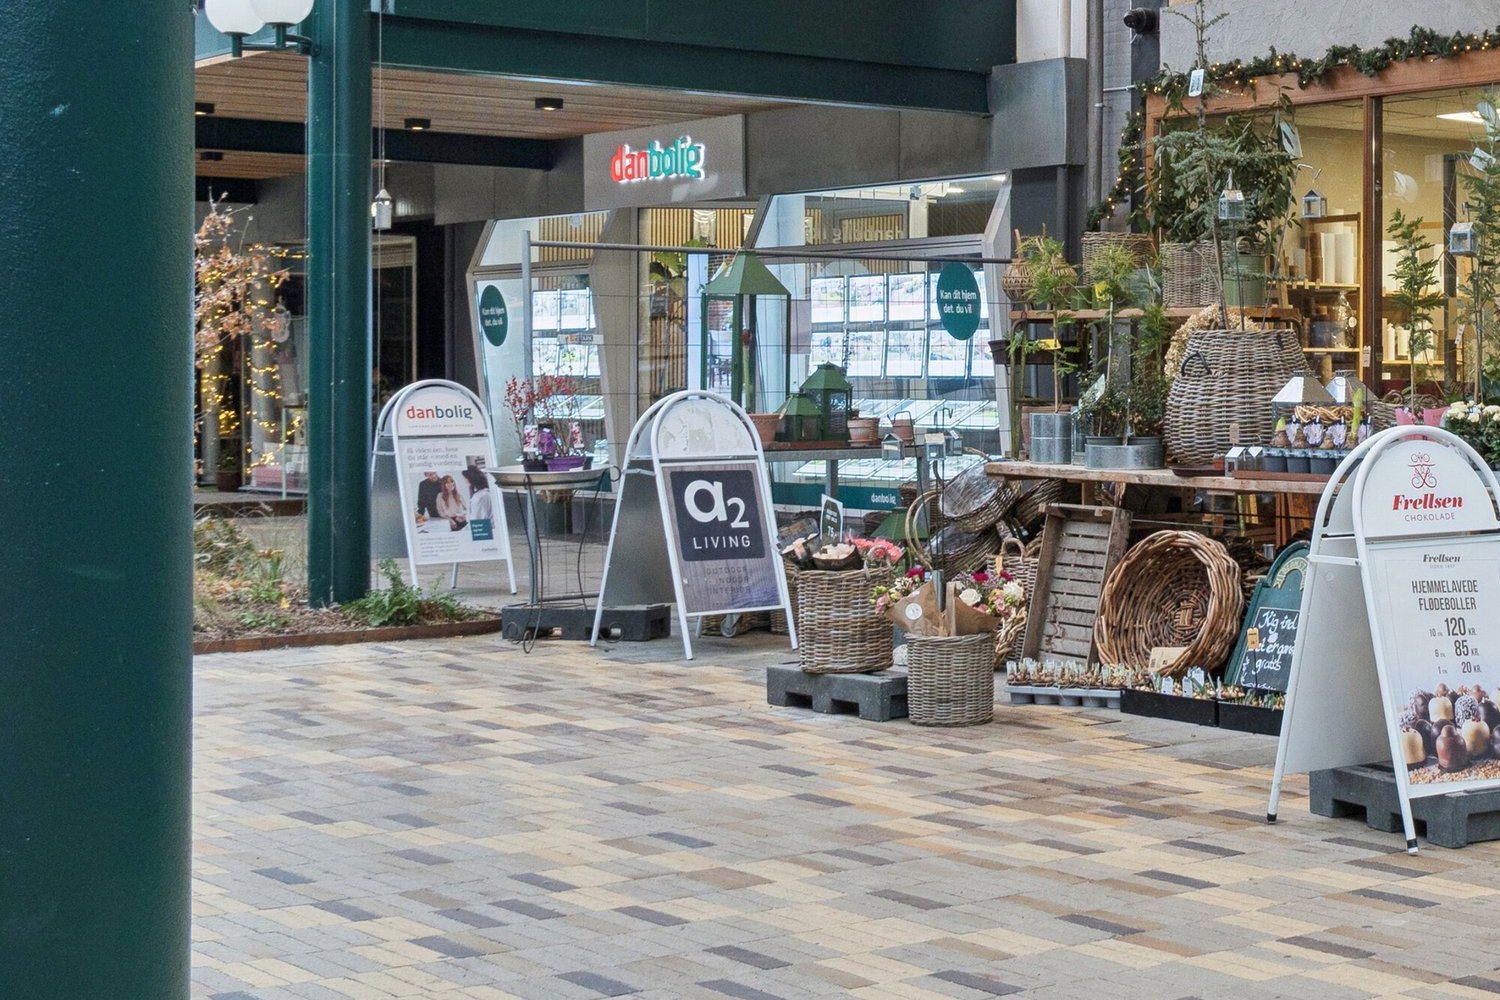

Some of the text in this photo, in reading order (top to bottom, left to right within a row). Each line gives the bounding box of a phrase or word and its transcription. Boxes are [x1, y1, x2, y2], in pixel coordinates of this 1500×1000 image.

[611, 136, 702, 182] danbolig
[939, 289, 977, 302] Kan dit hjem
[955, 303, 964, 314] du
[406, 405, 472, 420] danbolig
[871, 492, 897, 505] danbolig
[1392, 493, 1463, 511] Frellsen
[1404, 512, 1456, 522] CHOKOLADE
[693, 535, 751, 550] LIVING
[1423, 554, 1461, 563] Frellsen
[1411, 579, 1479, 594] HJEMMELAVEDE
[1418, 597, 1477, 611] FLØDEBOLLER
[1444, 617, 1466, 636] 120
[1454, 640, 1469, 657] 85
[1461, 661, 1472, 674] 20
